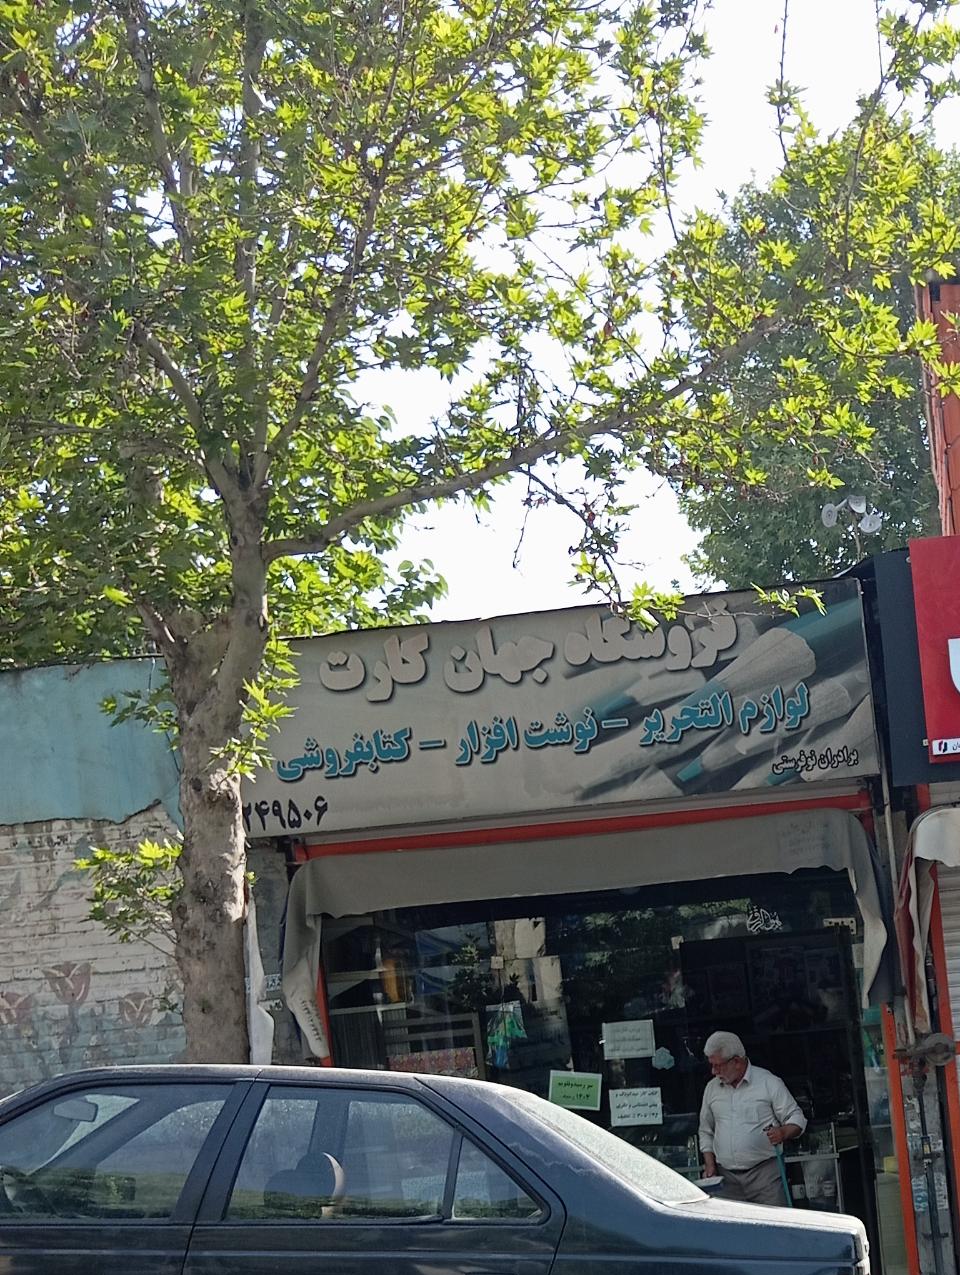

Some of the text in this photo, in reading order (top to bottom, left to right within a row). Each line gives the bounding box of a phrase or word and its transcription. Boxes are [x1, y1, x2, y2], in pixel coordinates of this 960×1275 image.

[319, 631, 430, 702] کارت
[443, 625, 555, 694] جهان
[523, 706, 599, 753] نوشت
[639, 691, 735, 746] التحریر
[738, 681, 810, 735] لوازم
[275, 725, 413, 782] کتابفروشی
[455, 716, 519, 766] افزار
[817, 744, 859, 770] برادران
